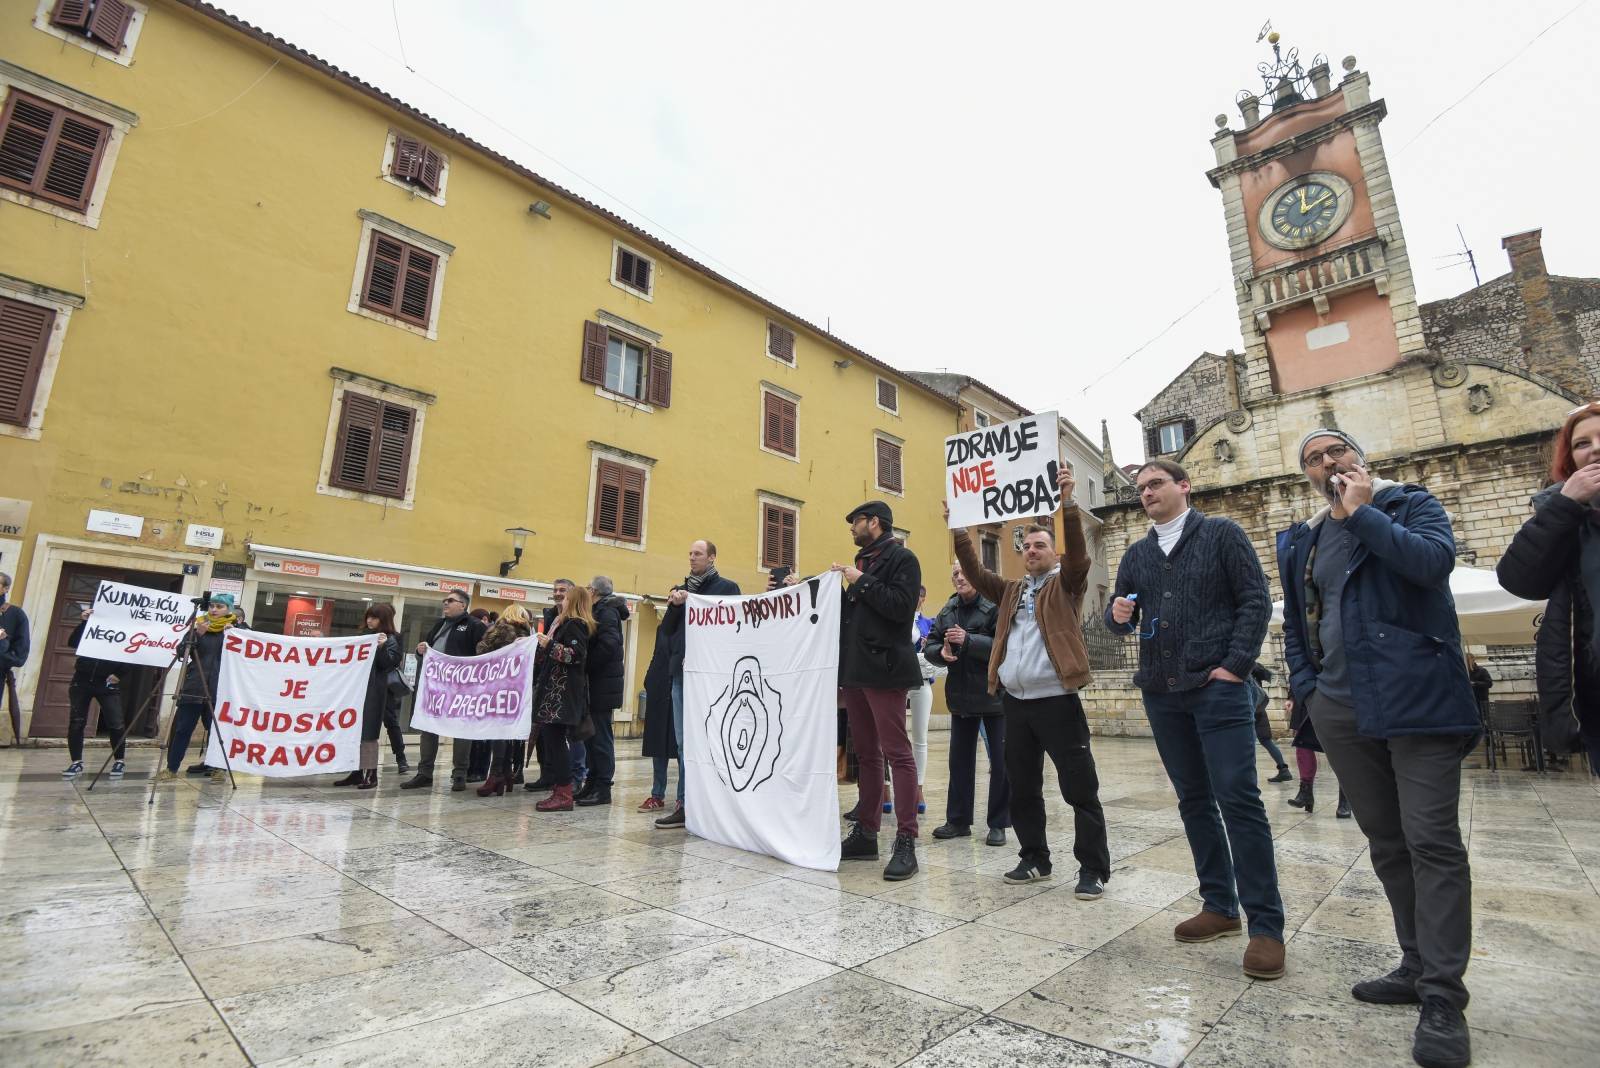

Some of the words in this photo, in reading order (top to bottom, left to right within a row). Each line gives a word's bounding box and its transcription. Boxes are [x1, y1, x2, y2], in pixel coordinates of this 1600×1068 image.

[946, 420, 1039, 467] ZDRAVLJE
[951, 460, 997, 498] NIJE
[982, 460, 1061, 519] ROBA!
[284, 562, 317, 575] Rodea
[368, 573, 397, 584] Rodea
[441, 581, 467, 591] Rodea
[501, 588, 525, 599] Rodea
[130, 608, 152, 621] VIŠE
[155, 612, 186, 625] TVOJIH
[688, 600, 741, 633] DUKIĆU,
[85, 625, 126, 643] NEGO
[124, 632, 180, 653] Ginekol
[225, 634, 373, 666] ZDRAVLJE
[279, 679, 310, 699] JE
[448, 689, 520, 718] PREGLED
[218, 701, 357, 734] LJUDSKO
[228, 738, 336, 767] PRAVO
